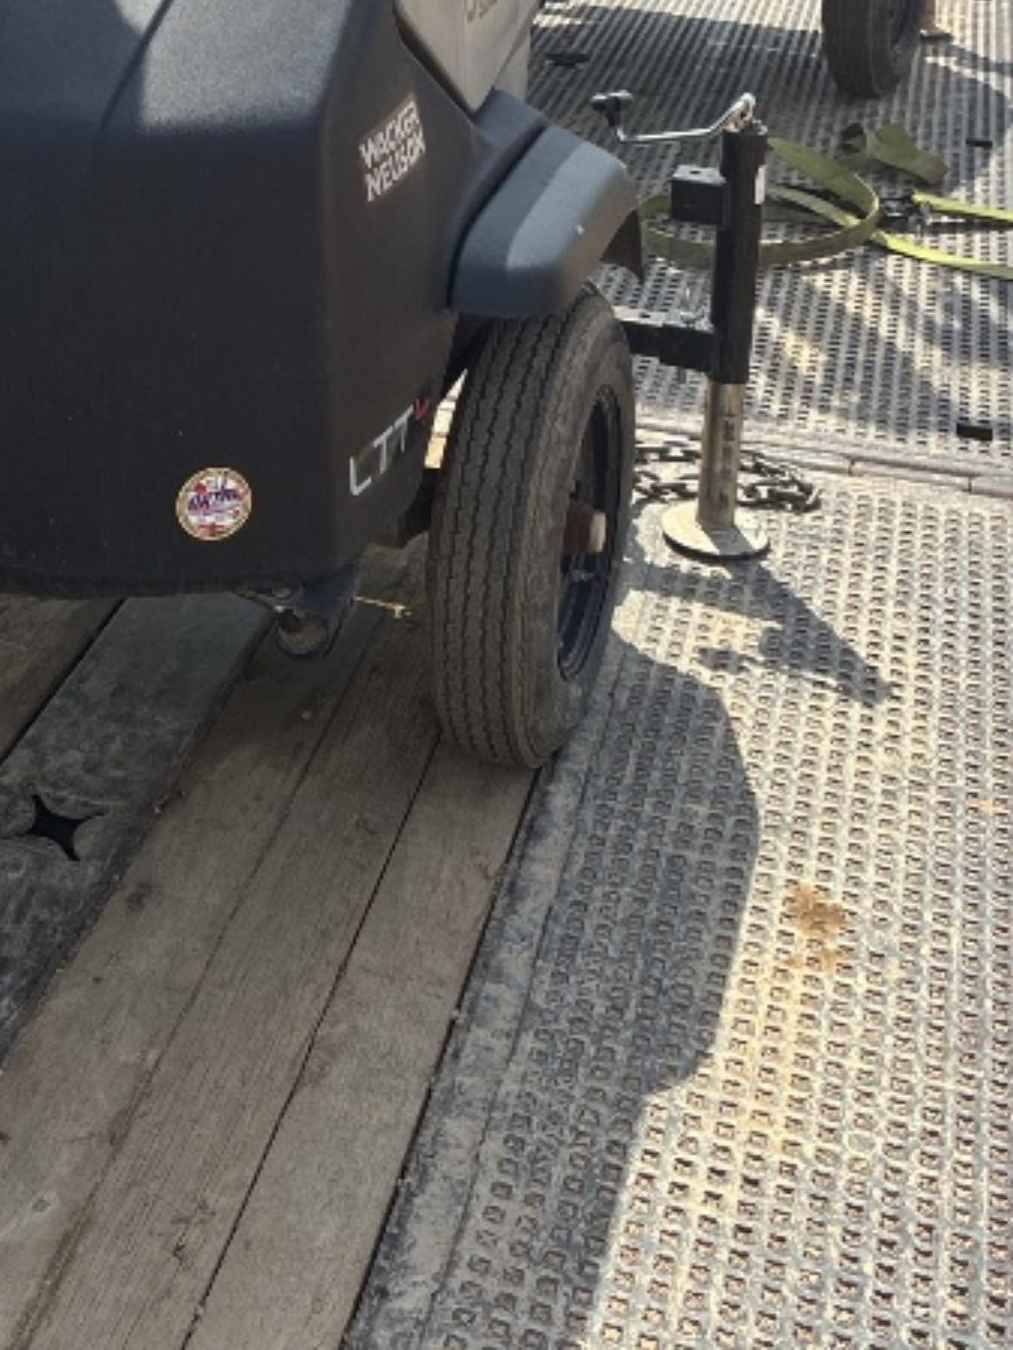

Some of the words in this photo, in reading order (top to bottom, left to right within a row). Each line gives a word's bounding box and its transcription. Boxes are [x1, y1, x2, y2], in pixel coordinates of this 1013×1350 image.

[358, 100, 421, 169] WACKER
[364, 130, 426, 202] NEUSON
[349, 403, 415, 497] LTT
